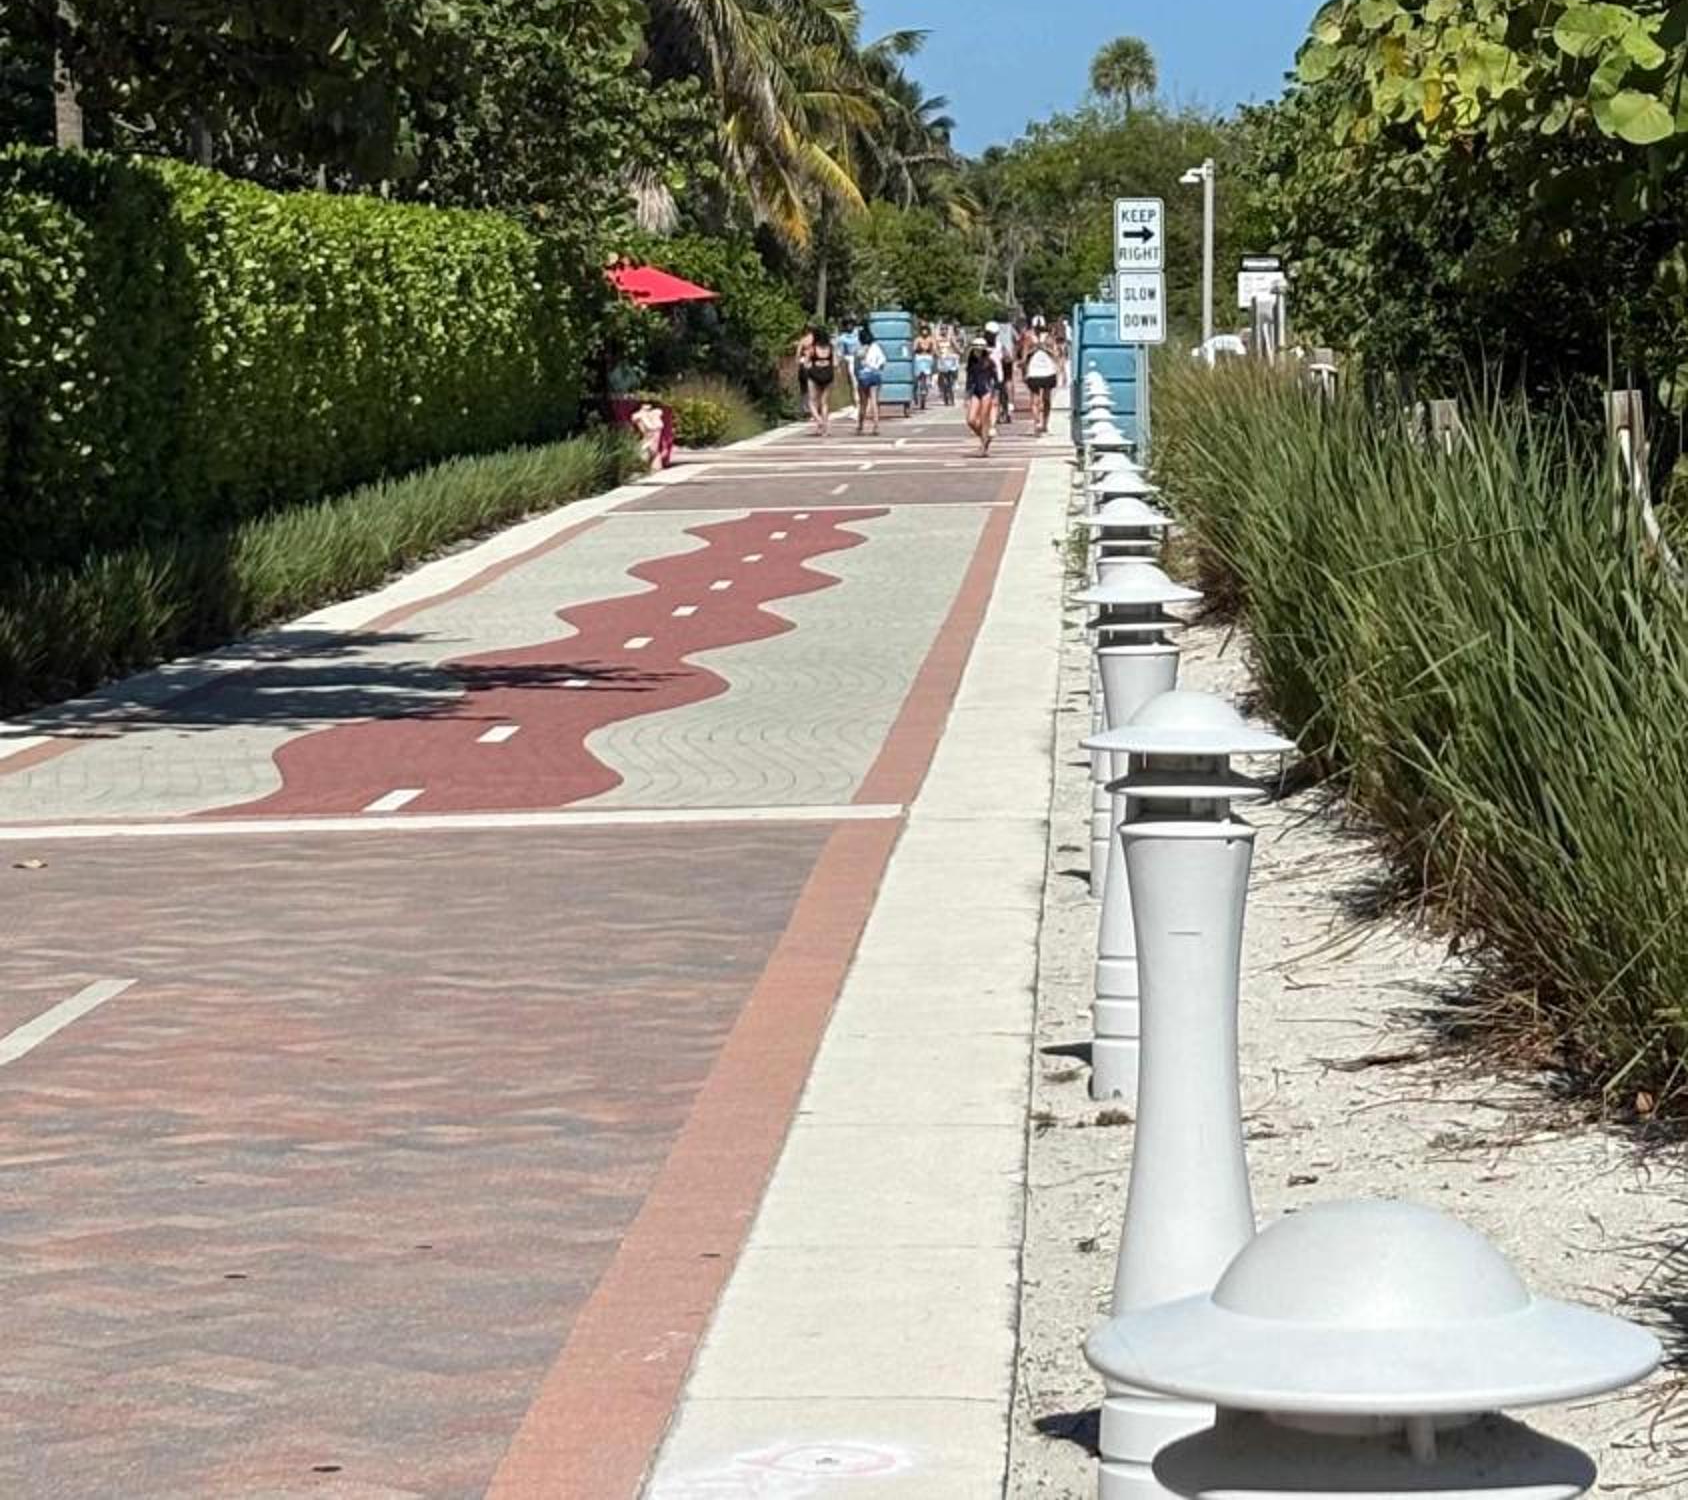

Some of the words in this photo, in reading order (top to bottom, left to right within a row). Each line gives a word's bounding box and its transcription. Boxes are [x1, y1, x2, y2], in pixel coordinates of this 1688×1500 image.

[1122, 210, 1156, 223] KEEP
[1119, 247, 1159, 261] RIGHT
[1124, 287, 1156, 301] SLOW
[1124, 314, 1157, 327] DOWN
